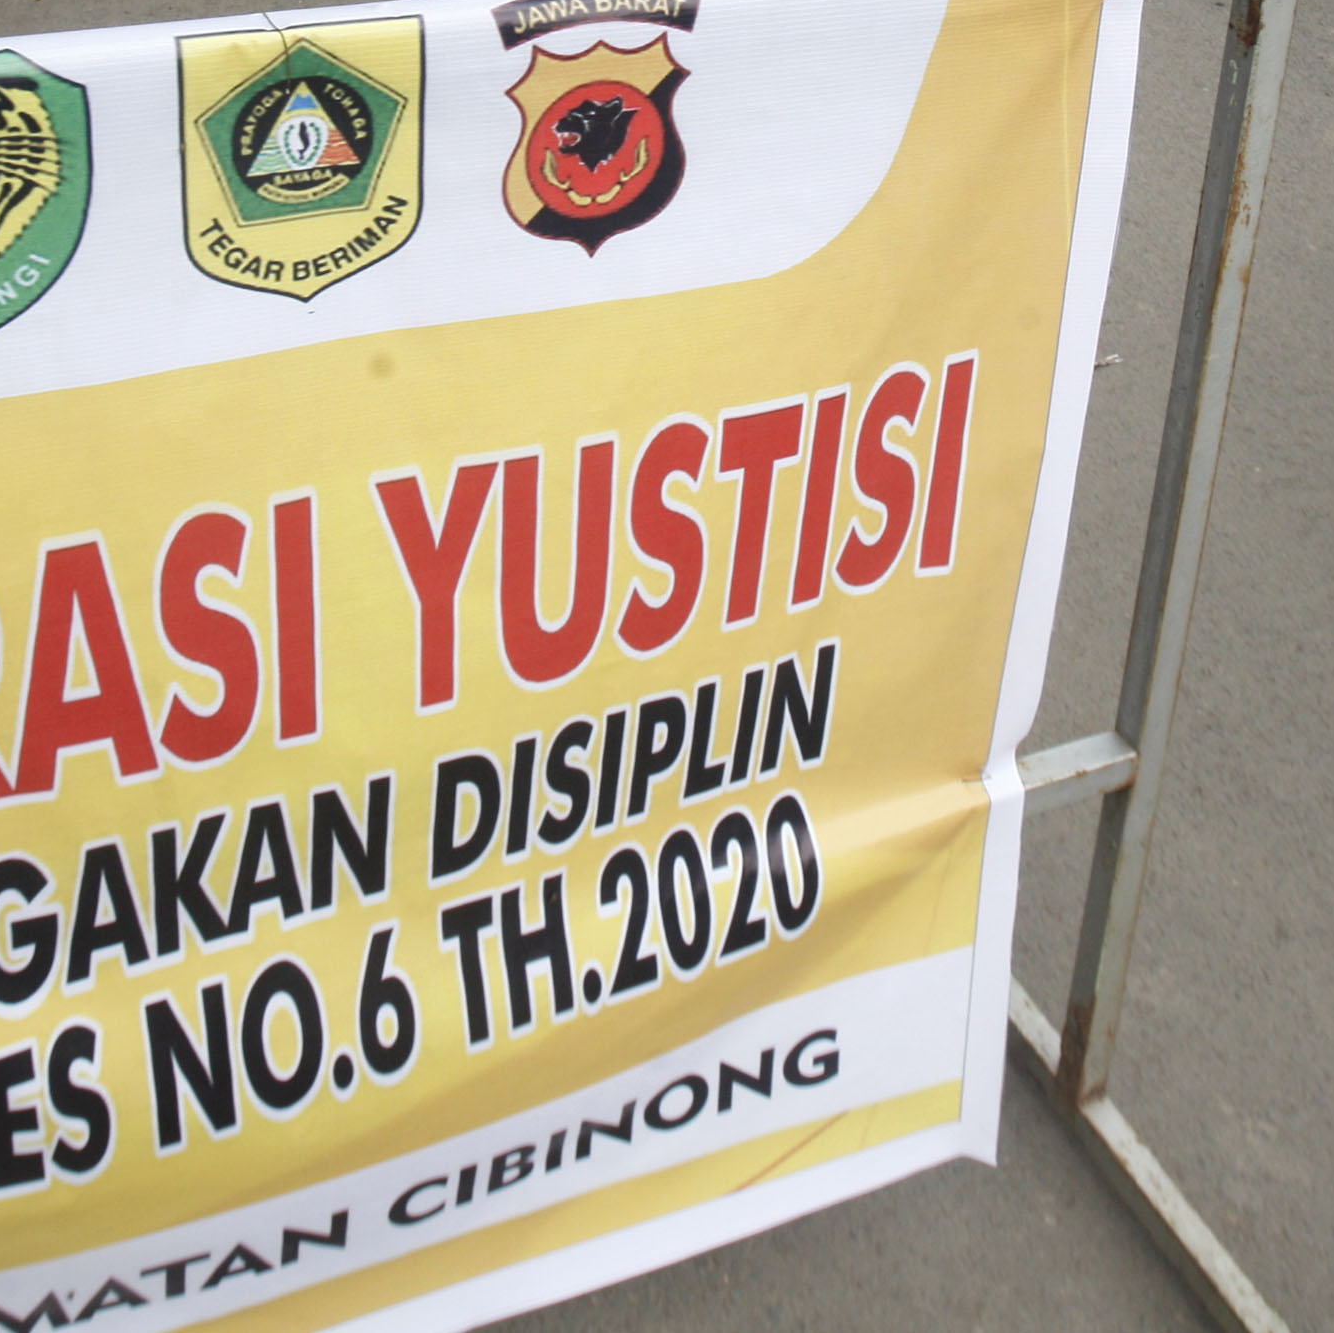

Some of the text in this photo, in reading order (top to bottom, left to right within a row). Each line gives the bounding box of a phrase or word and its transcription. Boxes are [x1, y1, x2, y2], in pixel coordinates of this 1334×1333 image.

[199, 194, 409, 283] TEGAR BERIMAN
[373, 355, 977, 710] YUSTISI
[430, 642, 837, 879] DISIPLIN
[144, 928, 417, 1149] NO.6
[441, 794, 820, 1045] TH.2020
[387, 1028, 841, 1227] CIBINONG
